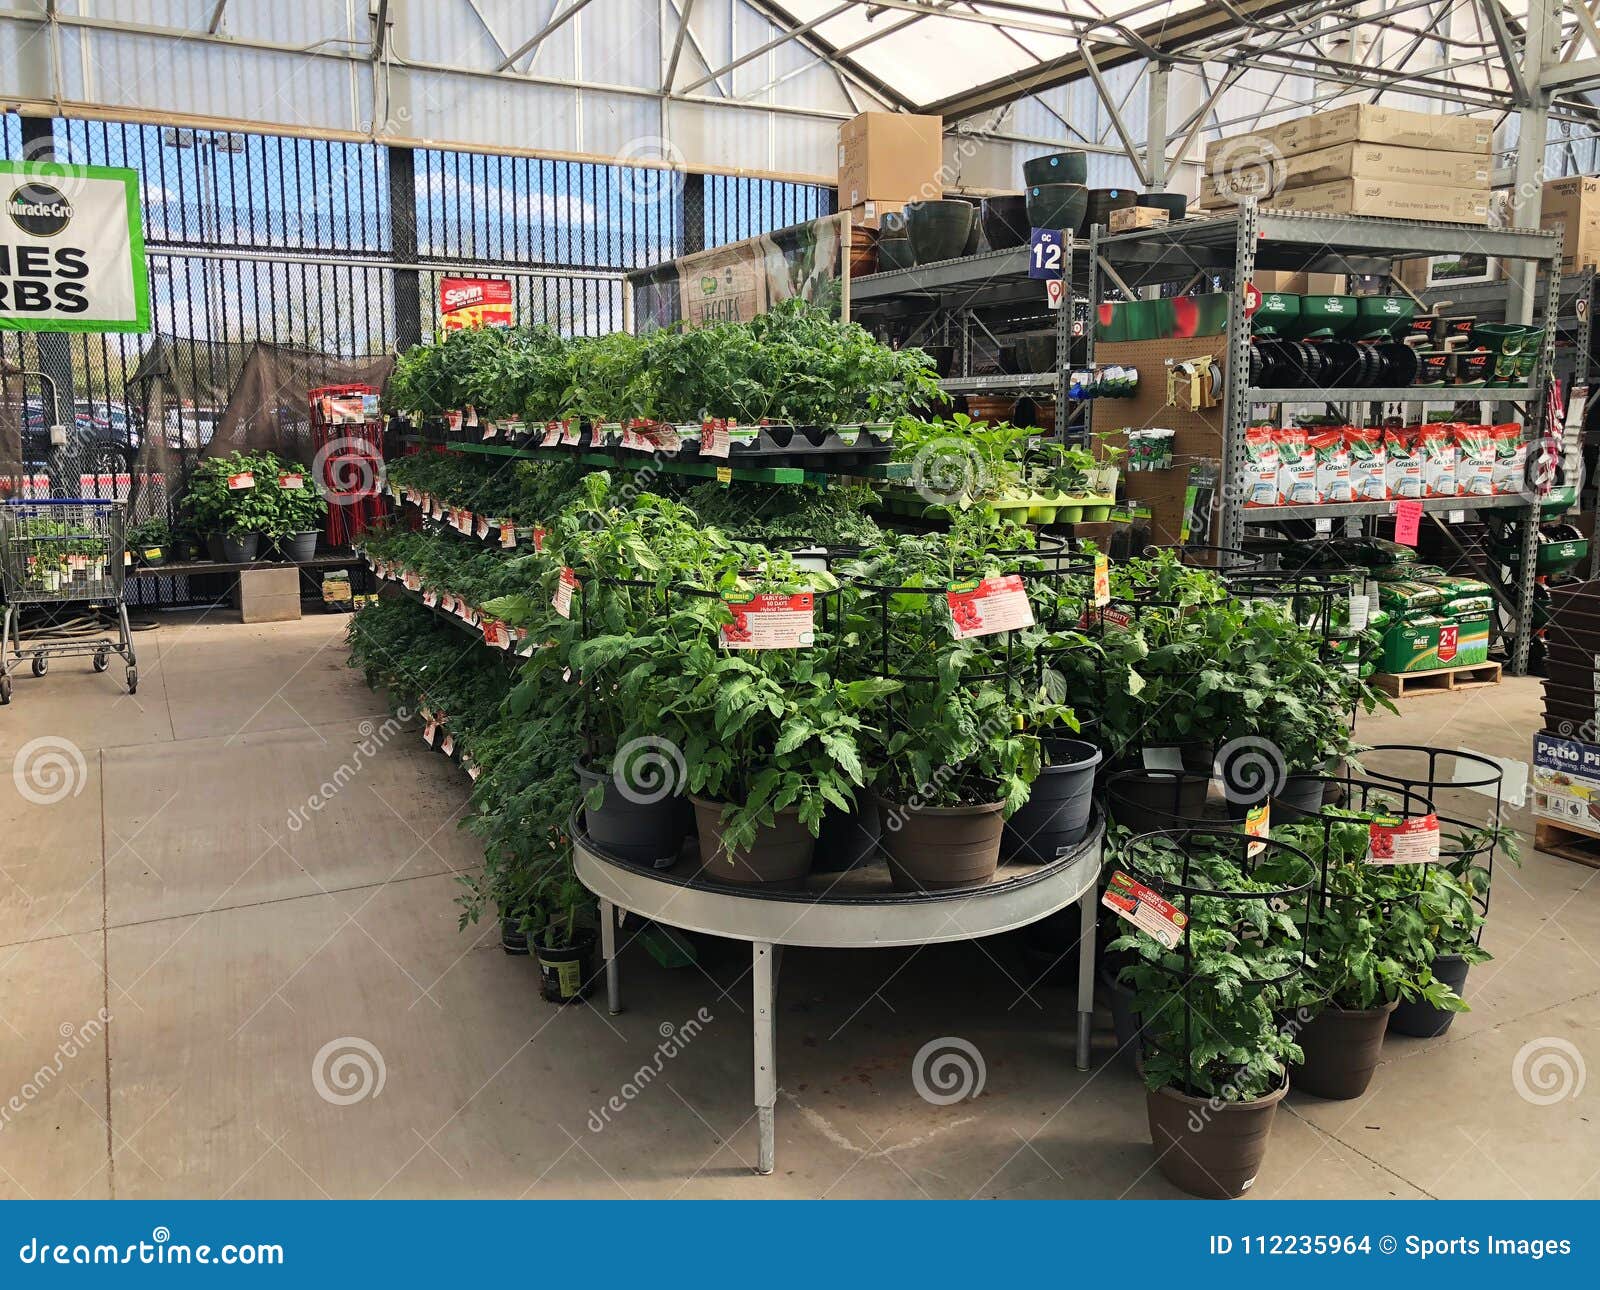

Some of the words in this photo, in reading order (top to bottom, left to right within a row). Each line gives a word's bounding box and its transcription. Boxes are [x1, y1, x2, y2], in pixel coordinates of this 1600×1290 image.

[1041, 233, 1052, 242] GC
[0, 245, 90, 279] ES
[1033, 243, 1061, 270] 12
[445, 285, 482, 306] Sevin
[1246, 292, 1256, 309] B
[1537, 741, 1580, 761] Patio
